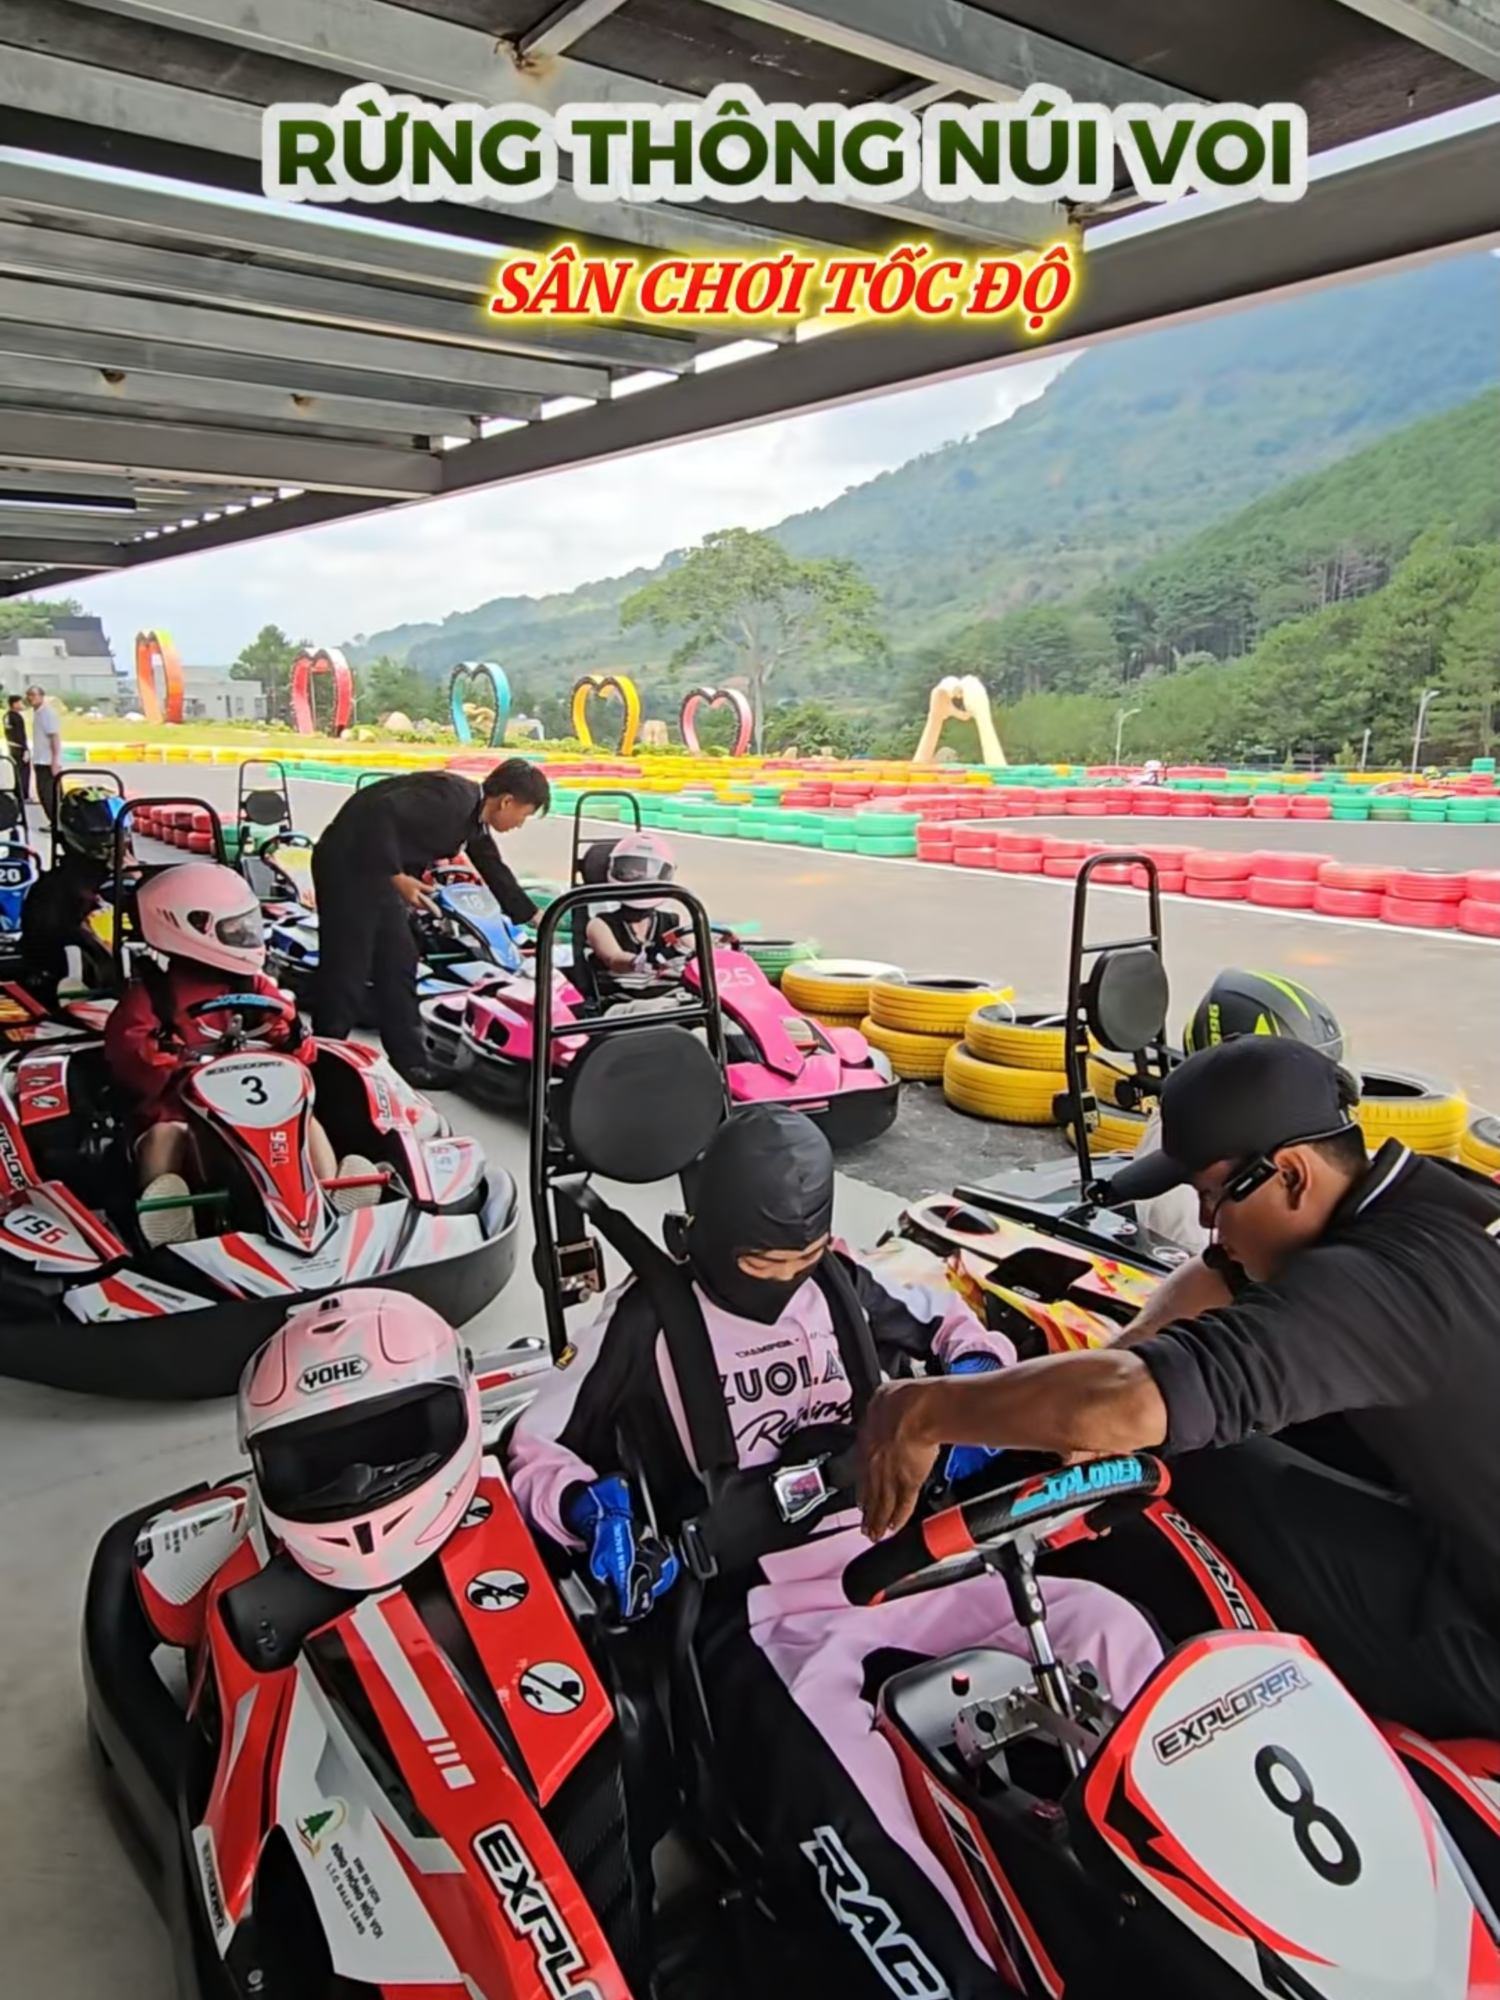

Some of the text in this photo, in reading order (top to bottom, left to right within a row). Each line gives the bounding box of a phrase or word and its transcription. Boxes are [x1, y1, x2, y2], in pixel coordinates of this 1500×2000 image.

[716, 967, 757, 988] 25
[240, 1075, 269, 1106] 3
[303, 1359, 363, 1389] YOHE
[1155, 1663, 1307, 1761] EXPLORER
[1254, 1744, 1363, 1887] 8
[475, 1826, 600, 2000] EXPL
